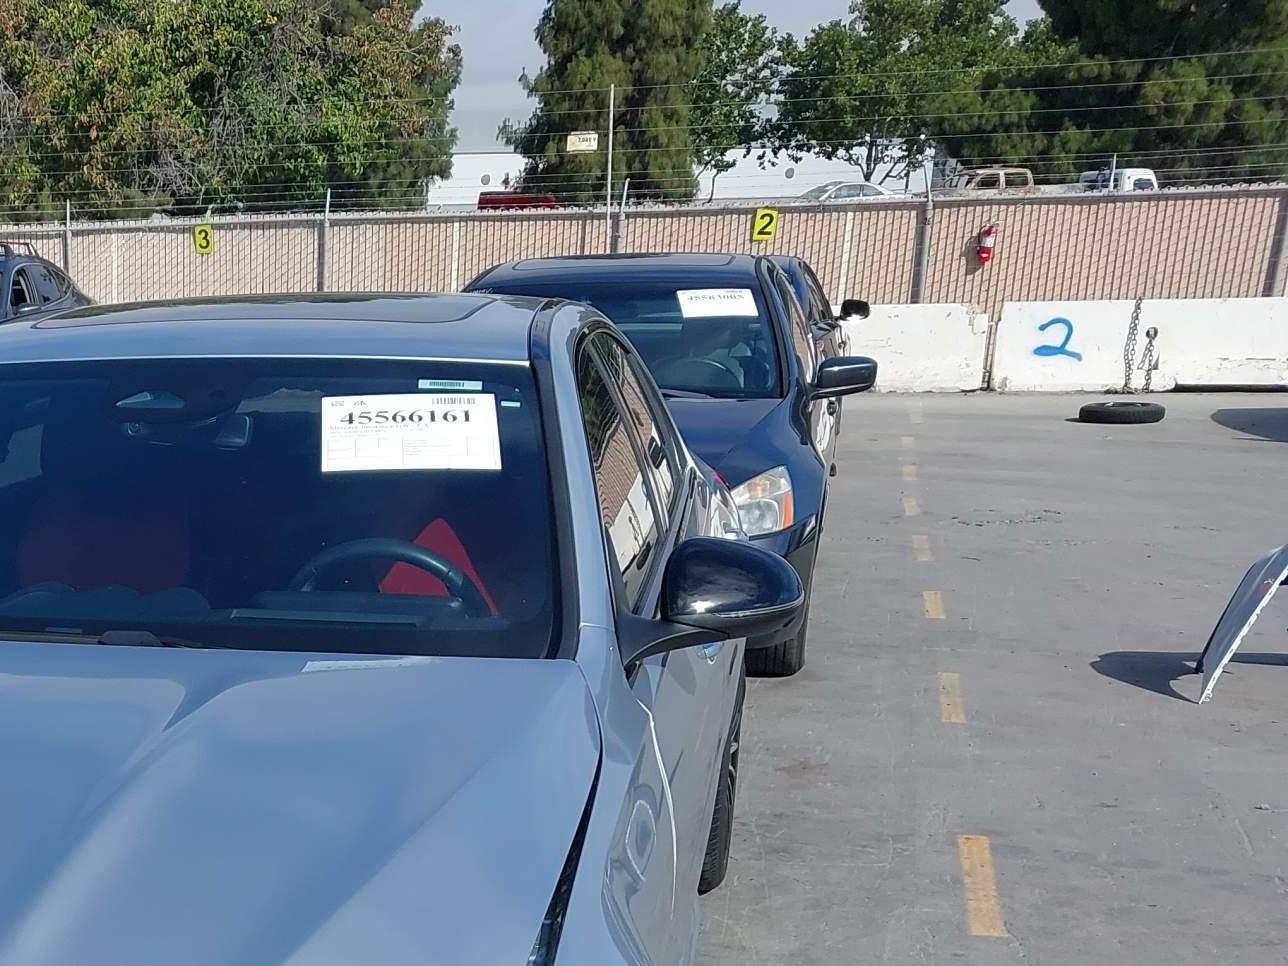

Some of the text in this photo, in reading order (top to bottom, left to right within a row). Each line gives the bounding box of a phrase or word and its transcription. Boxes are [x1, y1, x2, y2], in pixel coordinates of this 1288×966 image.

[757, 213, 774, 236] 2
[198, 229, 210, 249] 3
[1033, 317, 1083, 362] 2
[340, 408, 472, 425] 45566161
